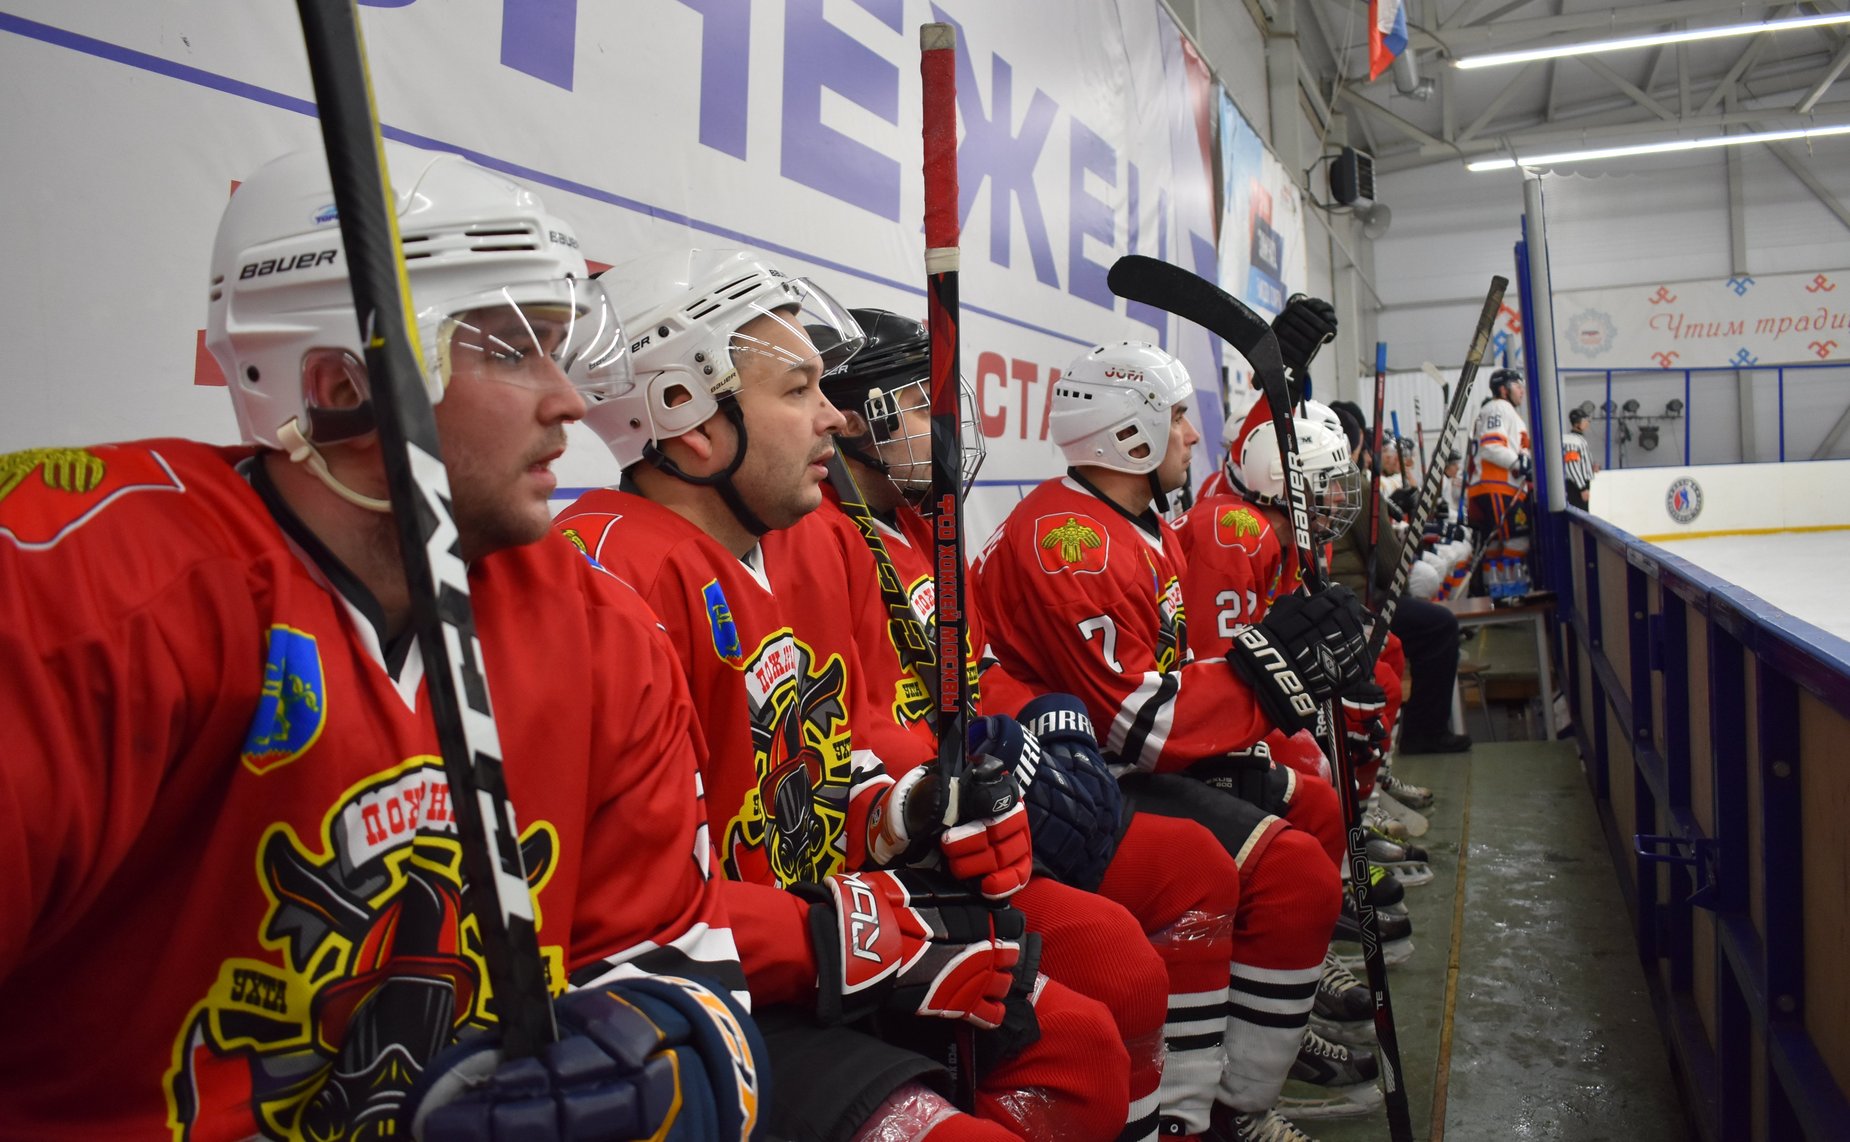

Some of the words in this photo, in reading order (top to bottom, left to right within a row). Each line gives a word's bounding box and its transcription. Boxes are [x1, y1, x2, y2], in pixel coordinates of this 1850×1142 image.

[1650, 312, 1744, 340] Чтим
[1755, 306, 1850, 341] тради
[1486, 415, 1502, 430] 66
[939, 542, 962, 622] ХОККЕЙ
[940, 625, 960, 713] МОСКВЫ
[1077, 614, 1123, 674] 7
[406, 441, 535, 931] CCM
[1348, 826, 1379, 962] VAPOR
[231, 968, 288, 1015] УХТА
